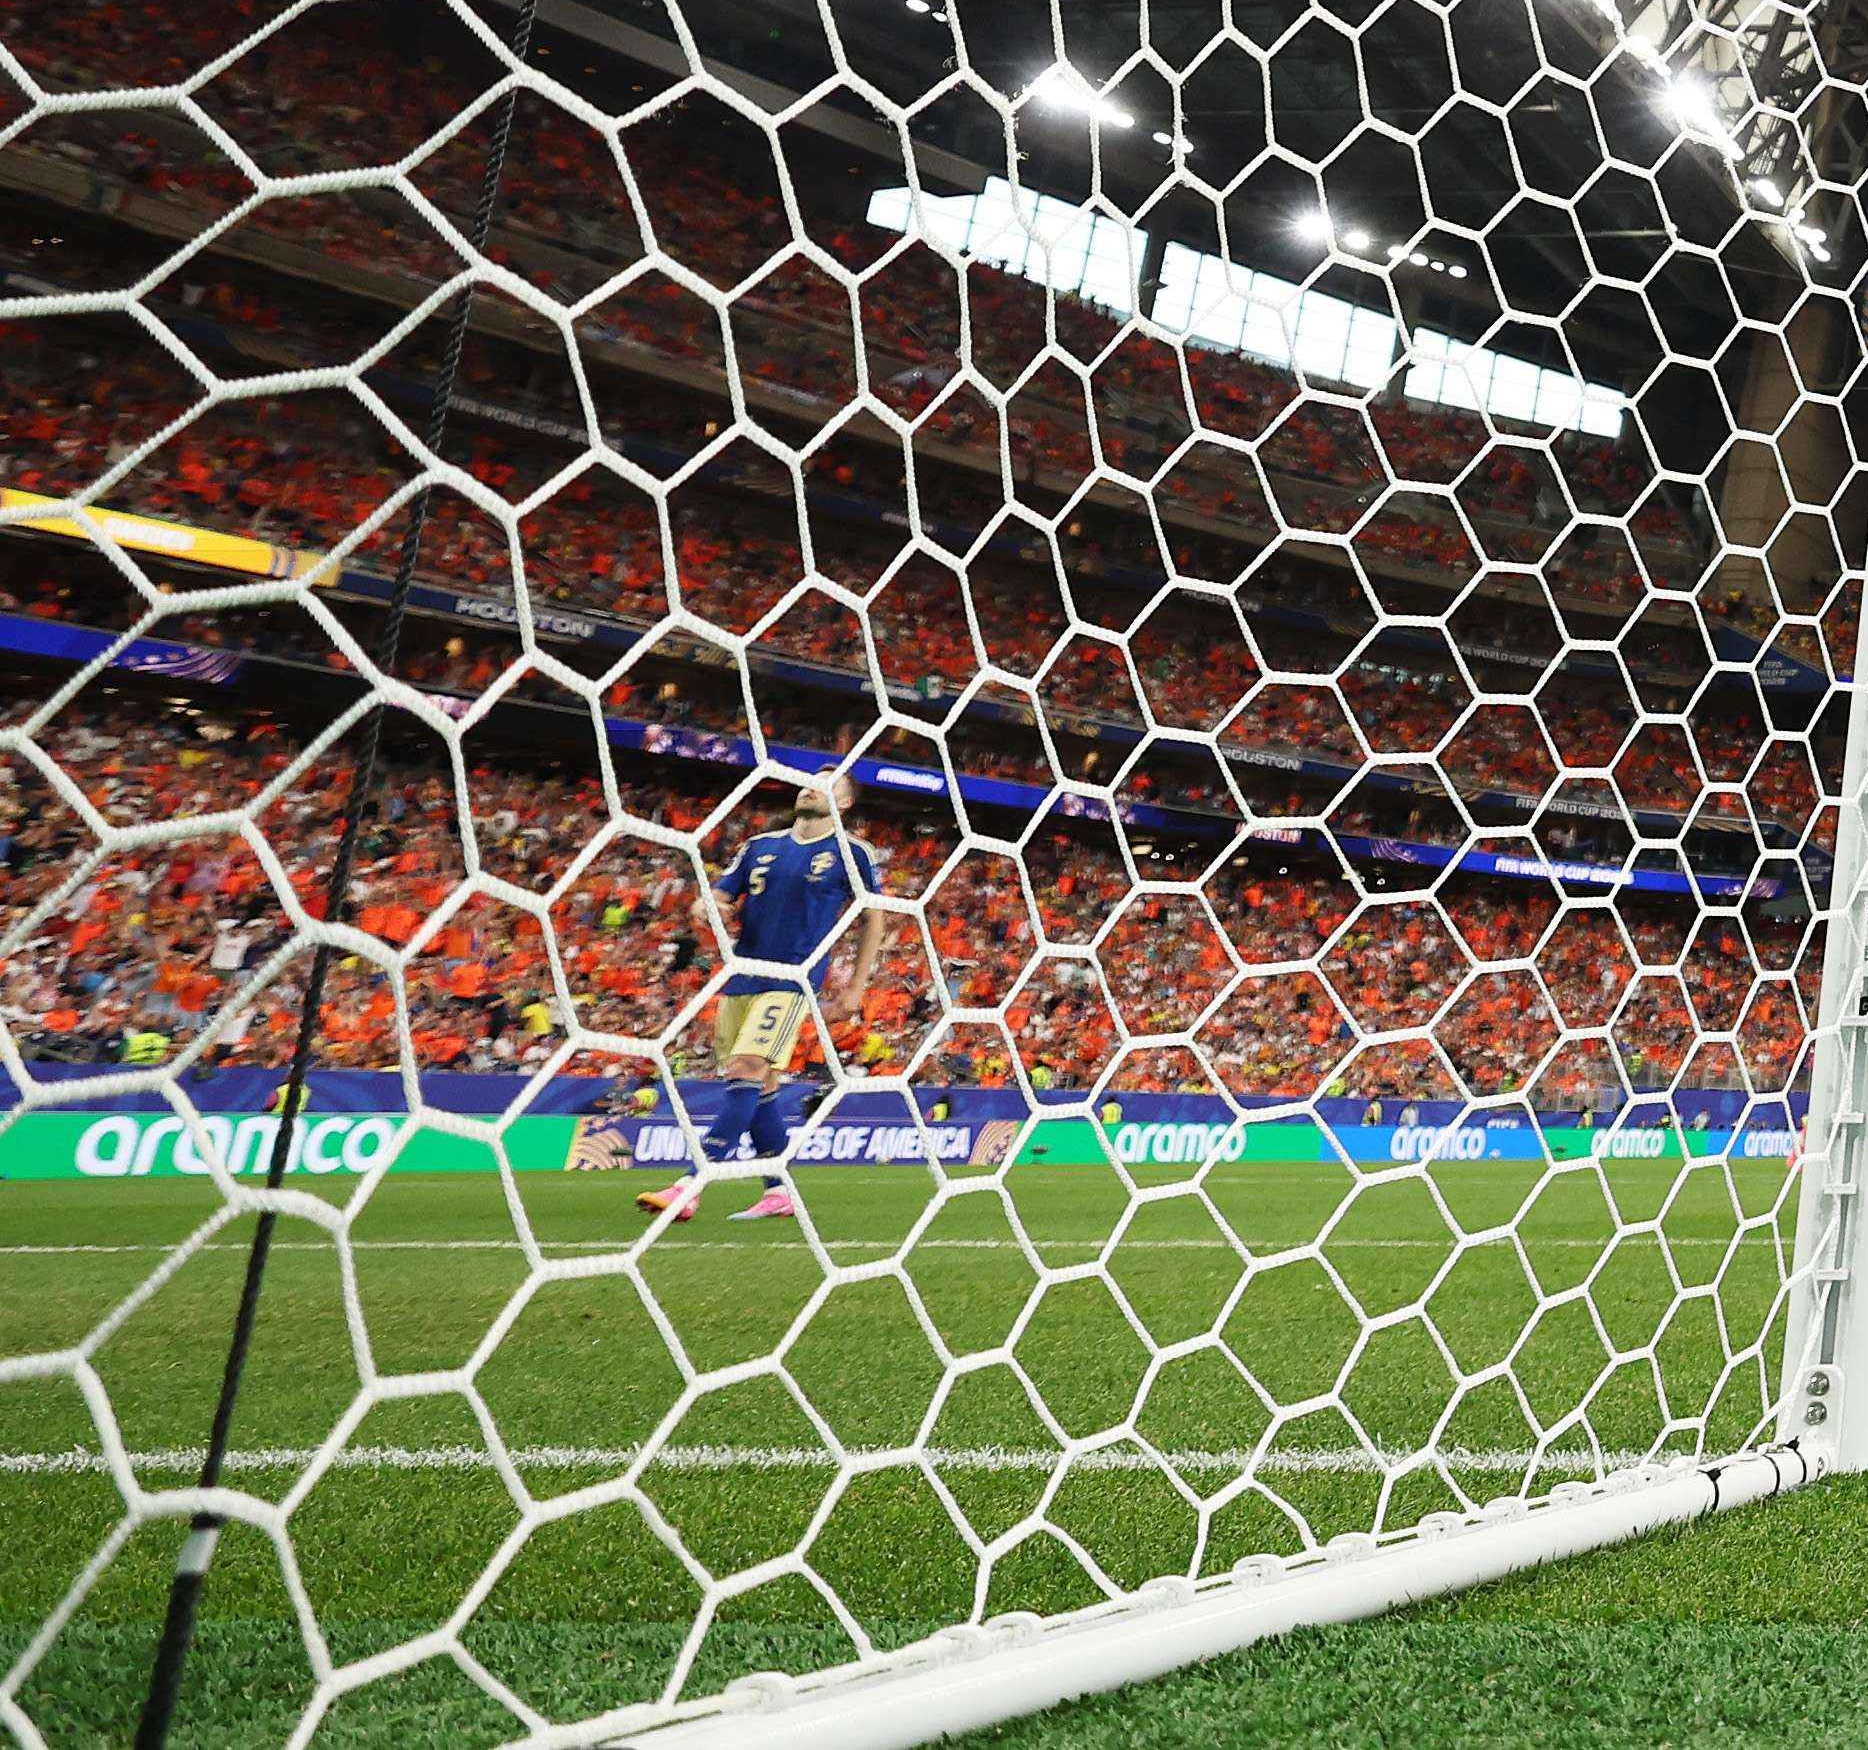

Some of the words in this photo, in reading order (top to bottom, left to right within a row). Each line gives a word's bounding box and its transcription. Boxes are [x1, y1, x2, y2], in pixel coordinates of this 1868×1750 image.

[747, 866, 770, 896] 5
[1495, 858, 1519, 874] FIFA
[1564, 865, 1589, 881] CUP
[759, 1005, 782, 1031] 5
[75, 1116, 395, 1177] aramco
[833, 1127, 867, 1160] OF
